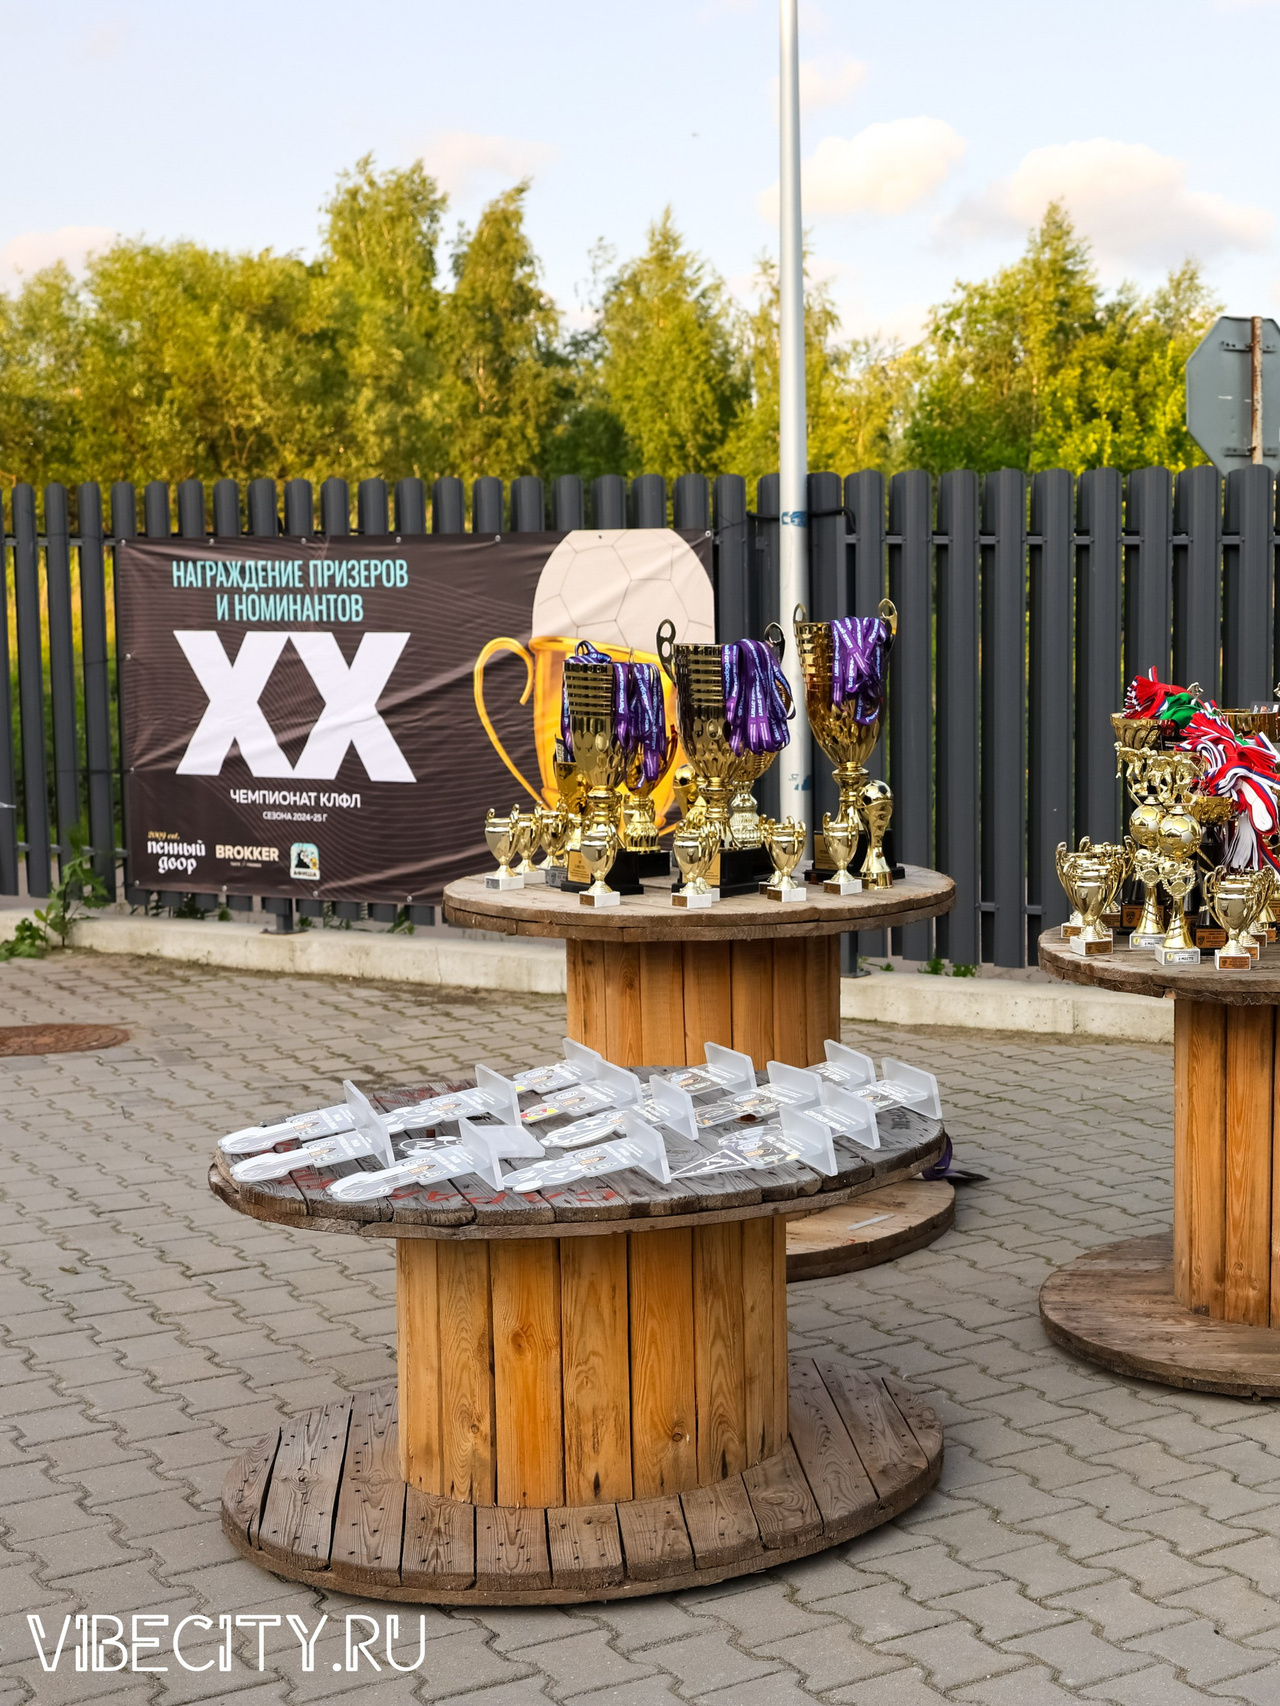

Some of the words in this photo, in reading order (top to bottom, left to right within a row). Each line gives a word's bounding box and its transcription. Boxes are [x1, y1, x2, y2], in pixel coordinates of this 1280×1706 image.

[172, 560, 304, 592] НАГРАЖДЕНИЕ
[308, 559, 409, 588] ПРИЗЕРОВ
[216, 593, 229, 622] И
[234, 593, 364, 622] НОМИНАНТОВ
[230, 789, 317, 806] ЧЕМПИОНАТ
[320, 793, 361, 808] КЛФЛ
[262, 811, 292, 821] СЕЗОНА
[293, 812, 322, 822] 2024-25
[215, 844, 279, 862] BROKKER
